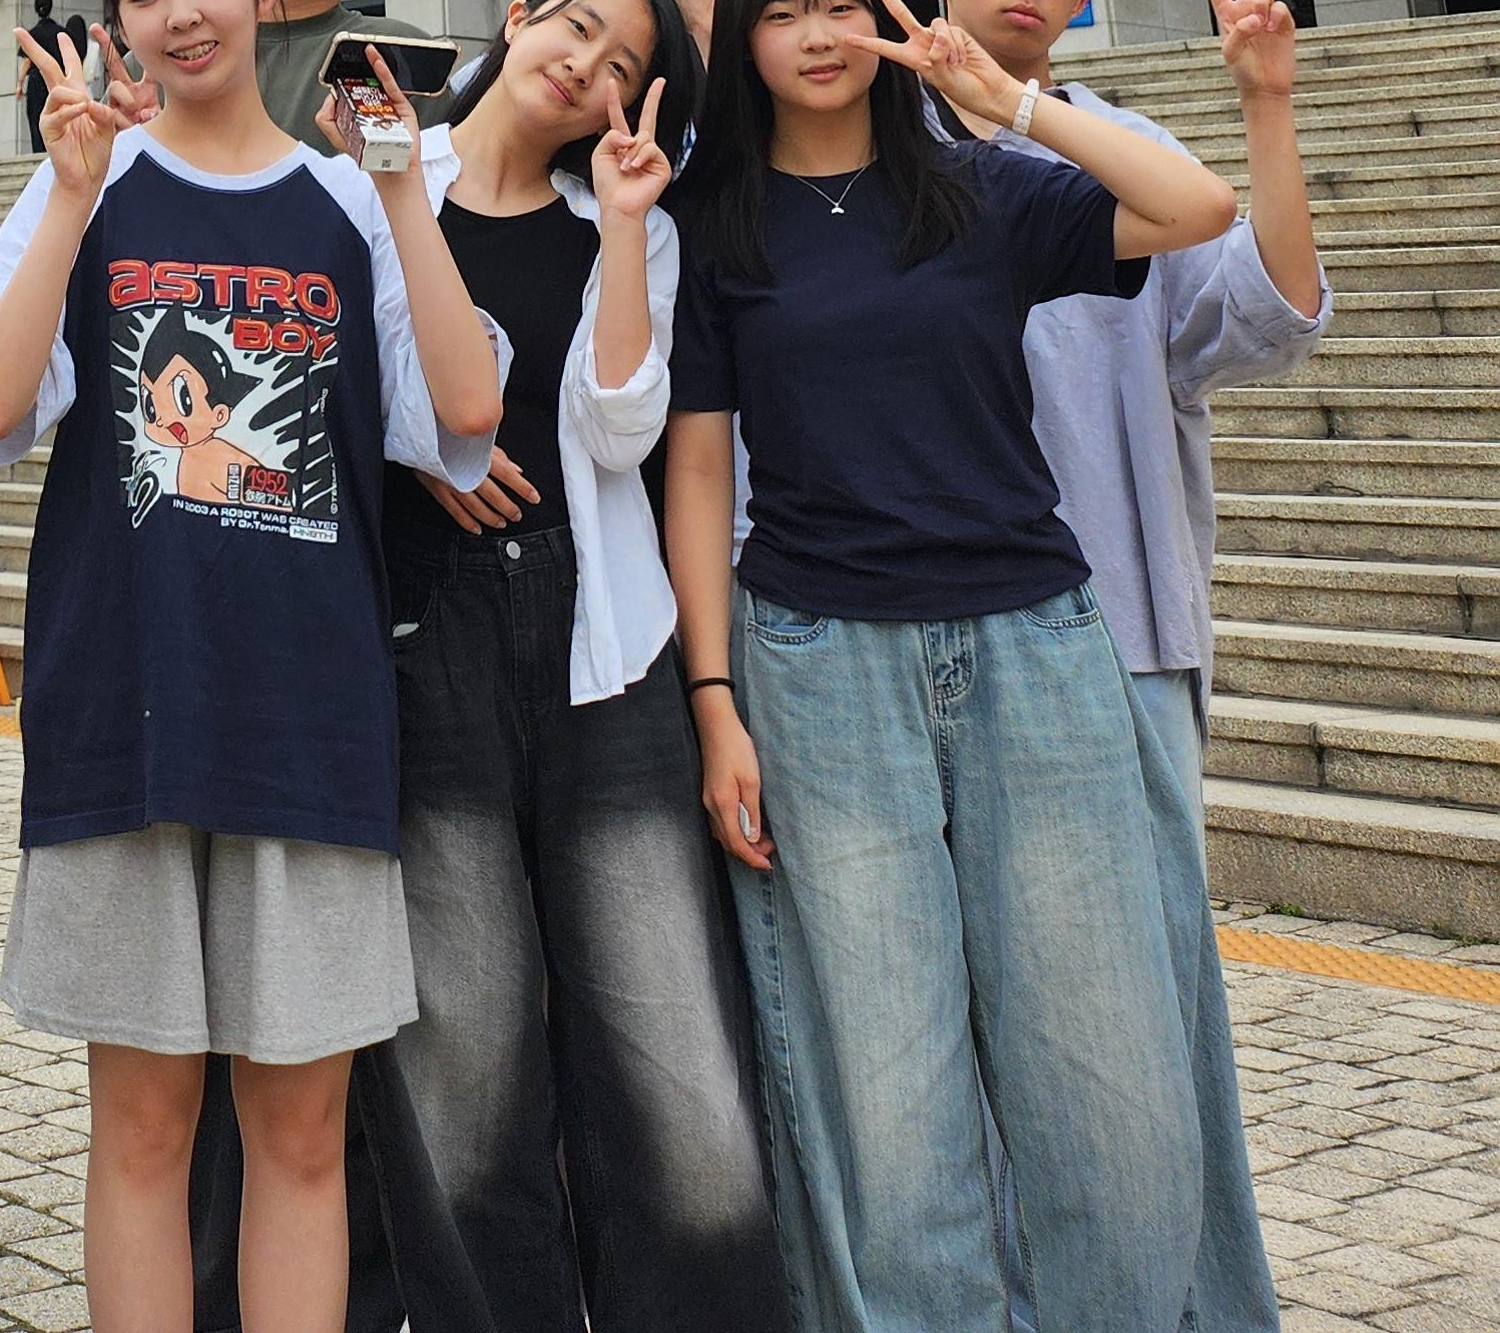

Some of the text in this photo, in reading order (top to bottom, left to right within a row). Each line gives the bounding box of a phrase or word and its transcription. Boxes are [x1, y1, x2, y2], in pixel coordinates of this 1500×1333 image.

[233, 317, 338, 365] BOY
[246, 467, 289, 495] 1952
[209, 507, 219, 516] A
[220, 507, 259, 521] ROBOT
[288, 515, 339, 531] CREATED
[220, 517, 237, 528] BY
